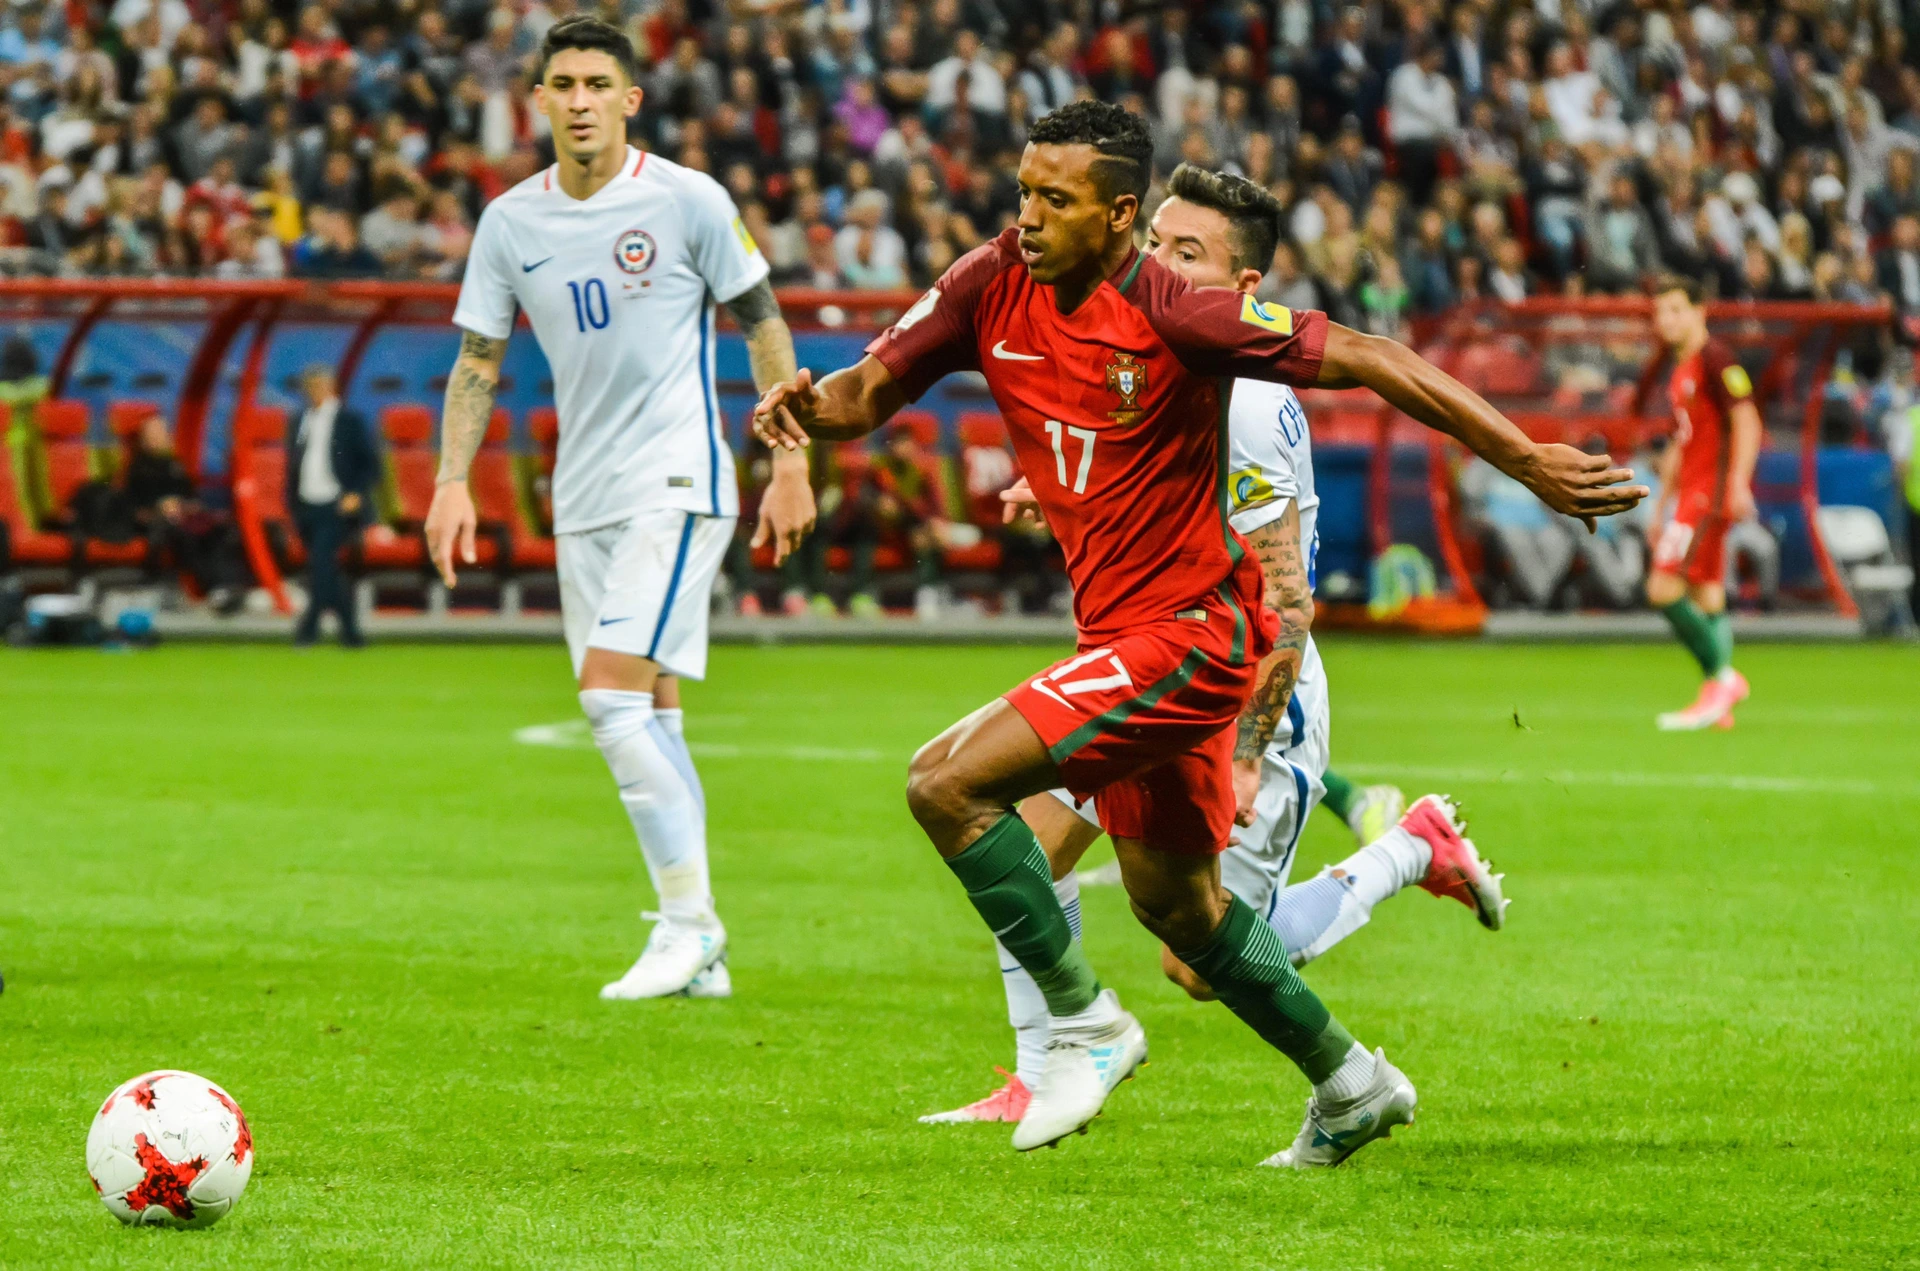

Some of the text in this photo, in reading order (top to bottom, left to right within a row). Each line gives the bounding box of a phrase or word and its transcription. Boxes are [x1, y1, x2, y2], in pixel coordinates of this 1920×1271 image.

[567, 278, 610, 332] 10
[1045, 420, 1097, 495] 17
[1048, 648, 1133, 696] 17
